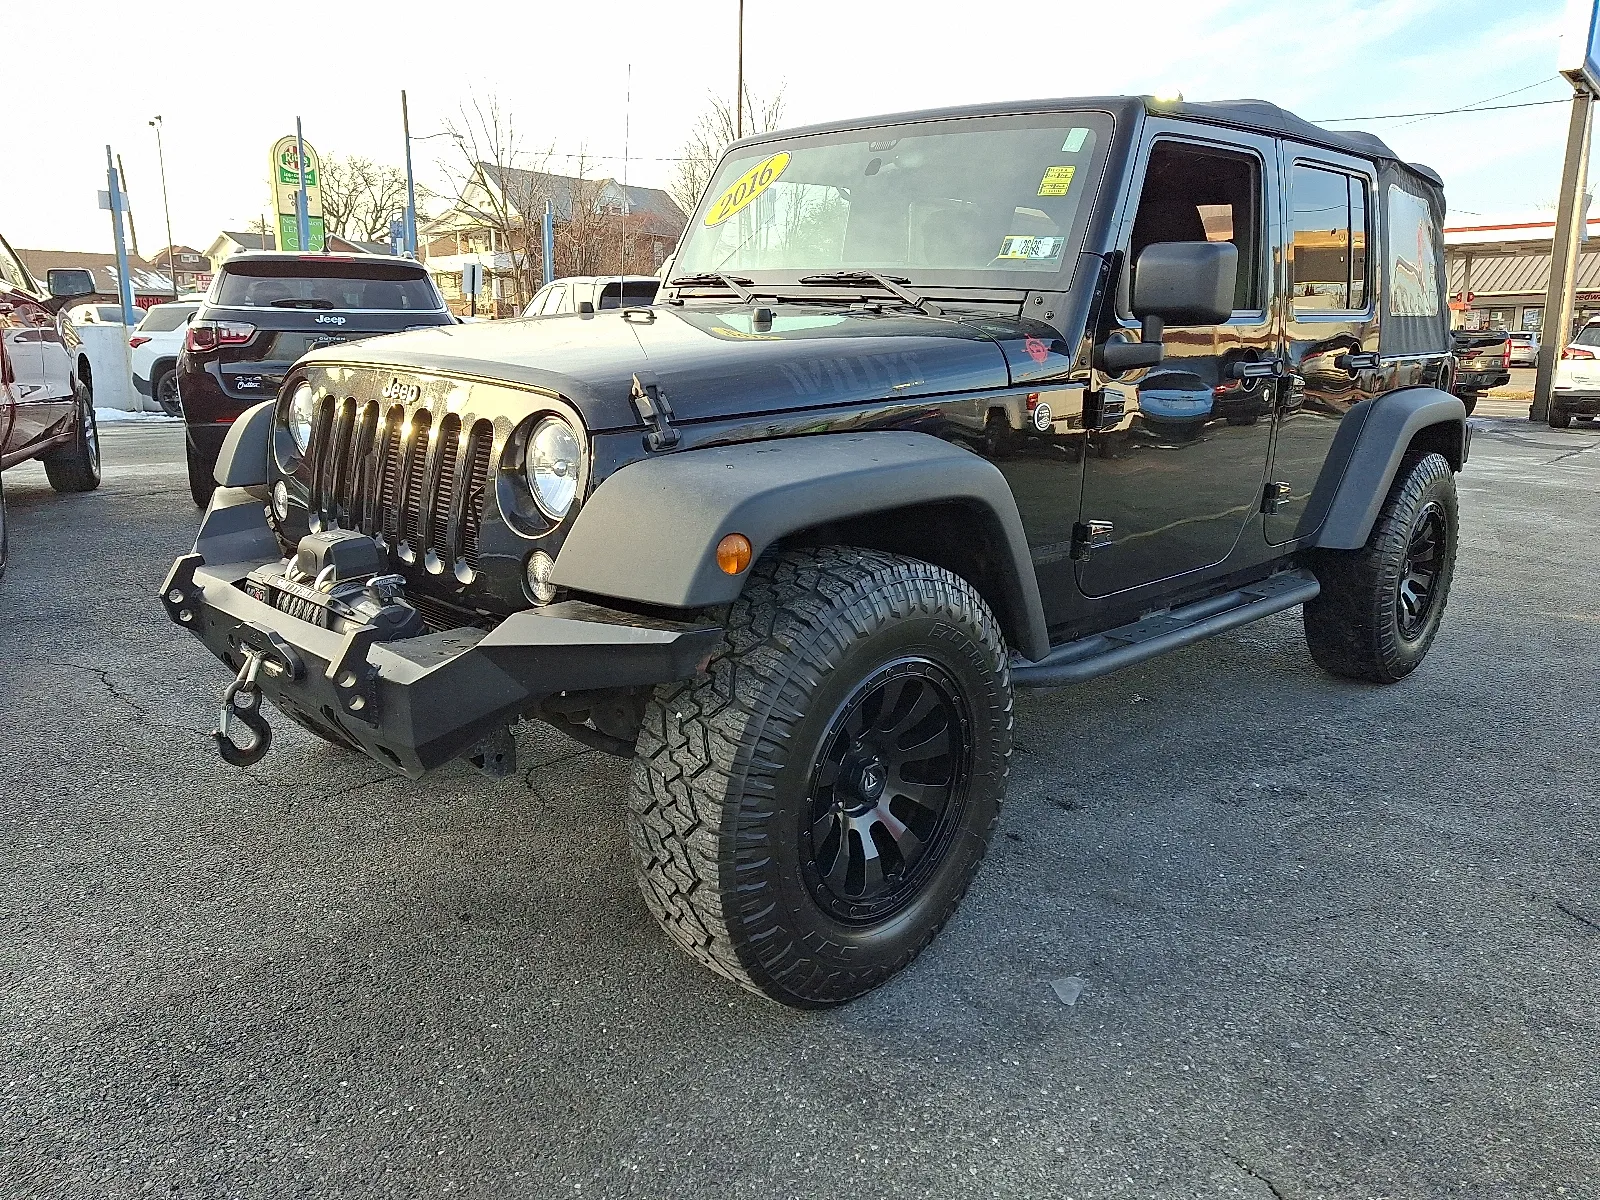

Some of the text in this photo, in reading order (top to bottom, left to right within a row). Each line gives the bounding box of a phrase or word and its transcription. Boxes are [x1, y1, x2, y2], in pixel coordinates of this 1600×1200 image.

[717, 158, 770, 219] 2016
[315, 315, 346, 326] Jeep
[382, 378, 421, 405] Jeep
[777, 351, 924, 396] WILLYS
